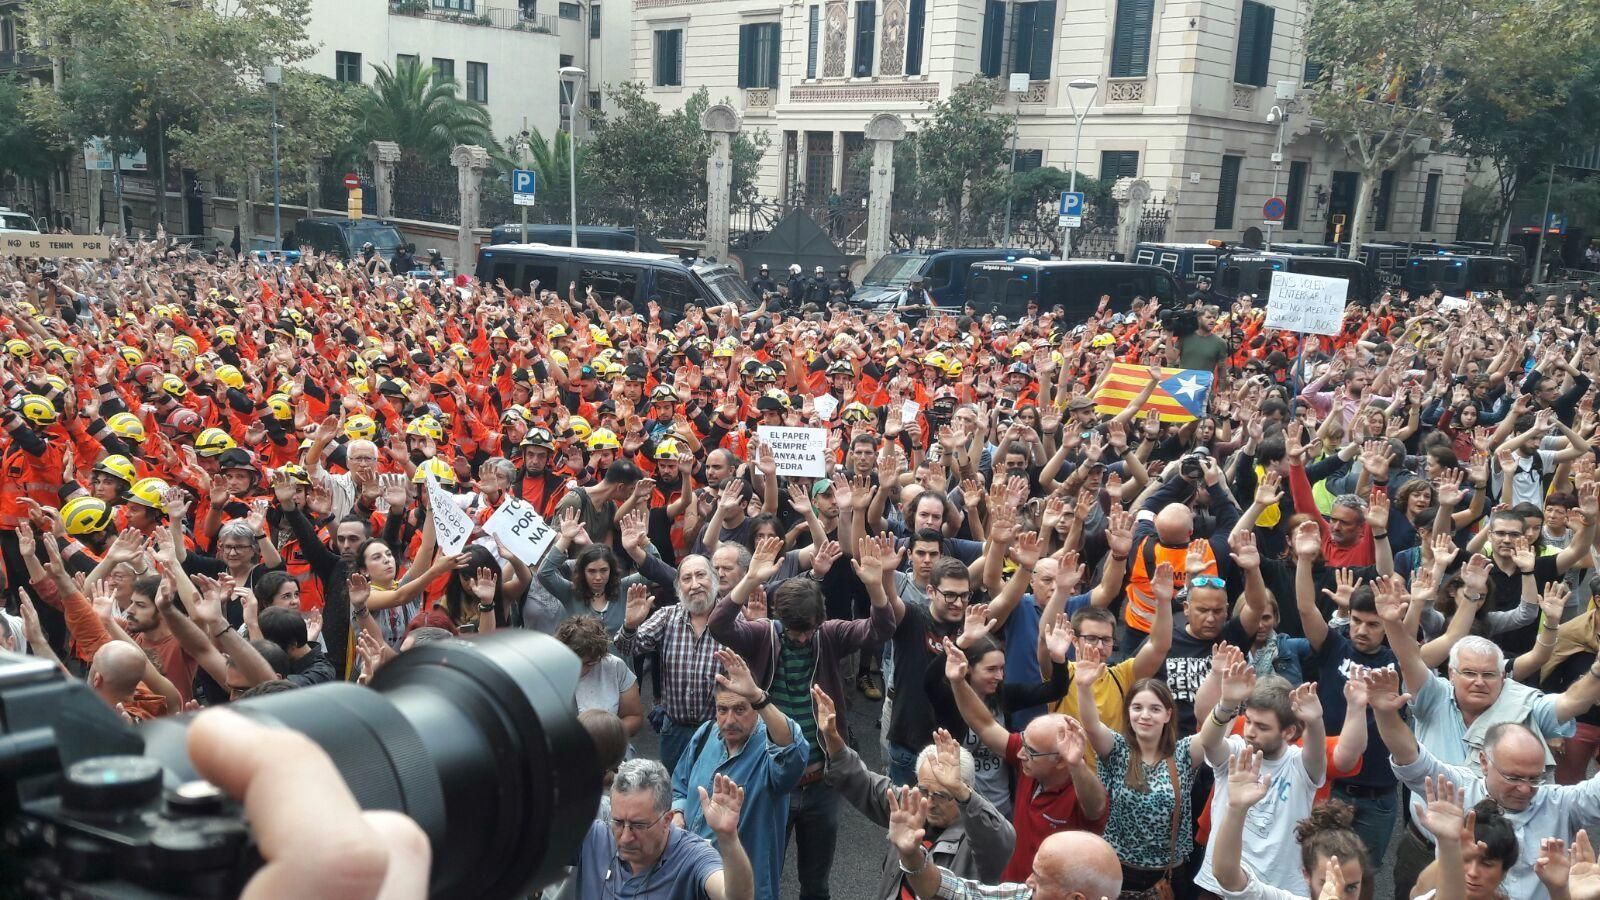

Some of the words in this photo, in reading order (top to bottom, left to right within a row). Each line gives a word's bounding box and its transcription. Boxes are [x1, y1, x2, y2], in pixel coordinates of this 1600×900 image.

[517, 173, 531, 191] P
[1064, 195, 1079, 213] P
[7, 239, 22, 248] NO
[29, 241, 40, 249] US
[49, 241, 74, 249] TENIM
[82, 241, 102, 250] POR
[770, 431, 780, 439] EL
[782, 432, 810, 440] PAPER
[772, 441, 808, 451] SEMPRE
[774, 452, 796, 460] ANYA
[805, 453, 816, 461] LA
[775, 462, 803, 471] PEDRA
[511, 510, 537, 537] POR
